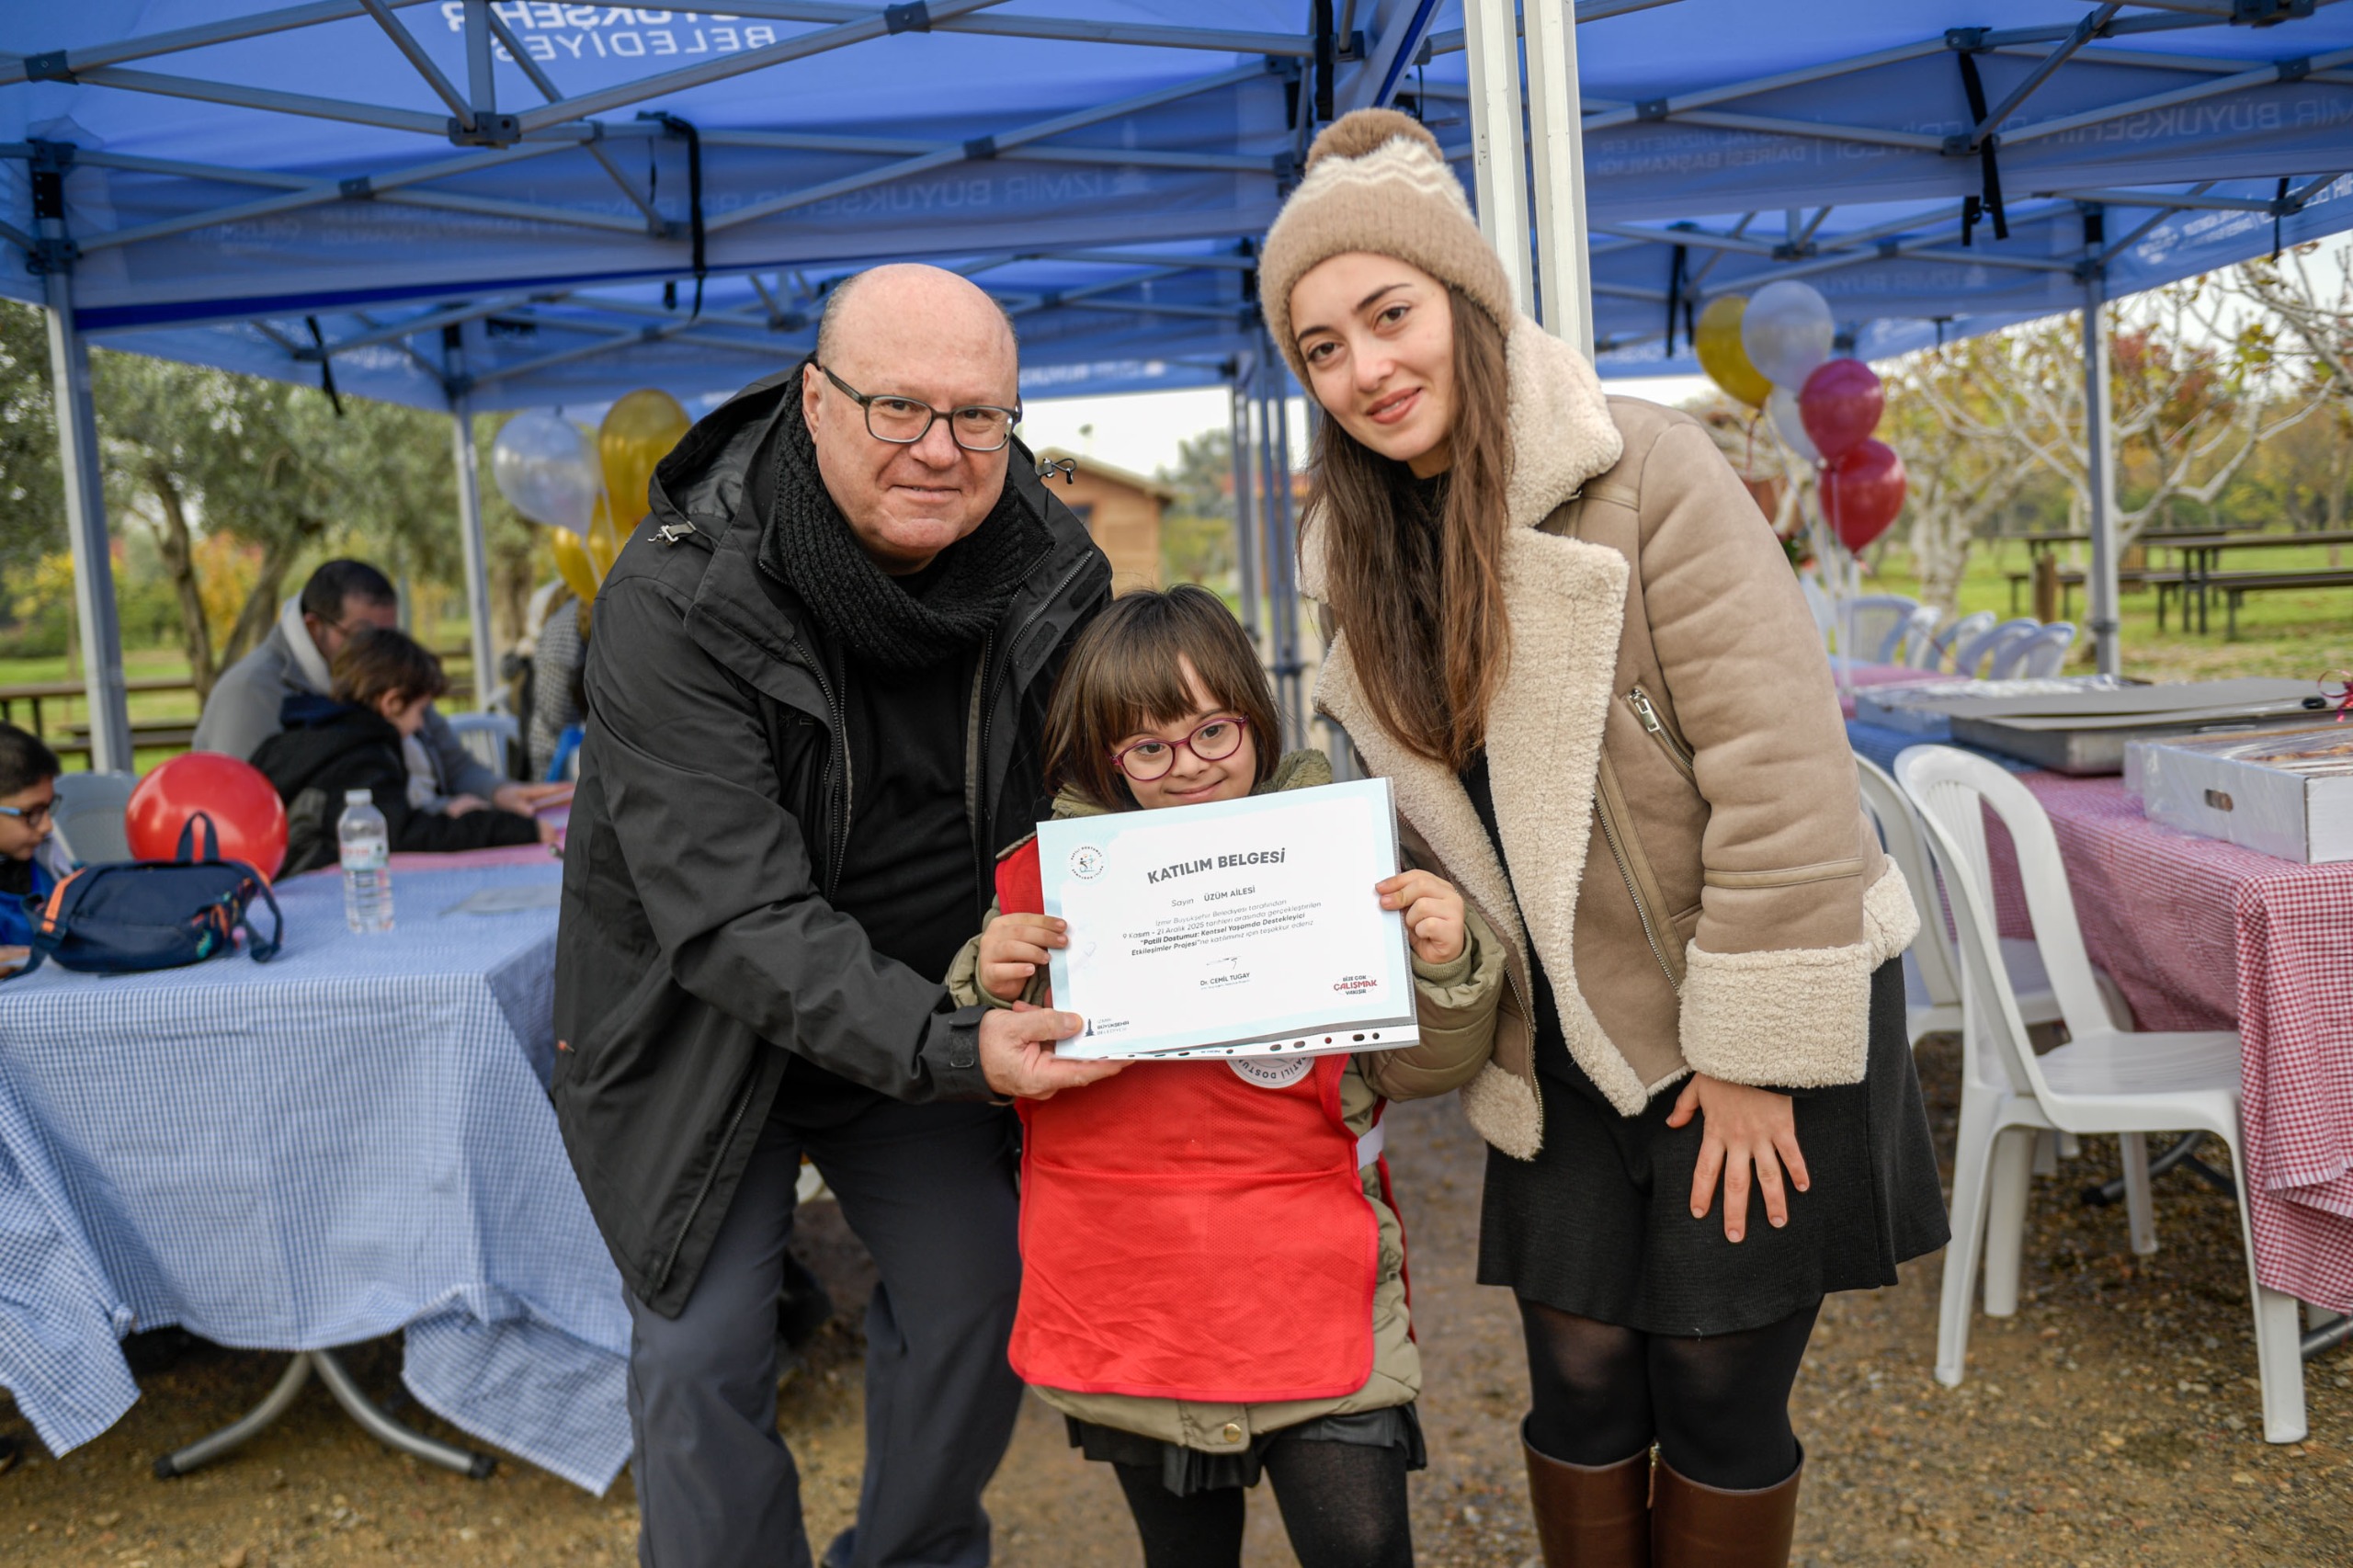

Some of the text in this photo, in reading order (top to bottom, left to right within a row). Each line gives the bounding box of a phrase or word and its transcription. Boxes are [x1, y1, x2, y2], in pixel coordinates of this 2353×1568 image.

[1147, 847, 1285, 884] KATILIM BELGESİ
[1171, 885, 1256, 907] Sayın ÜZÜM AİLESİ
[1129, 931, 1150, 939] Kasım
[1165, 925, 1185, 934] Aralık
[1187, 922, 1204, 930] 2025
[1234, 911, 1267, 922] arasında
[1200, 926, 1227, 937] Kentsel
[1228, 920, 1261, 932] Yaşamda
[1262, 913, 1305, 926] Destekleyici
[1131, 944, 1172, 956] Etkileşimler
[1210, 975, 1229, 984] CEMİL
[1230, 972, 1250, 981] TUGAY
